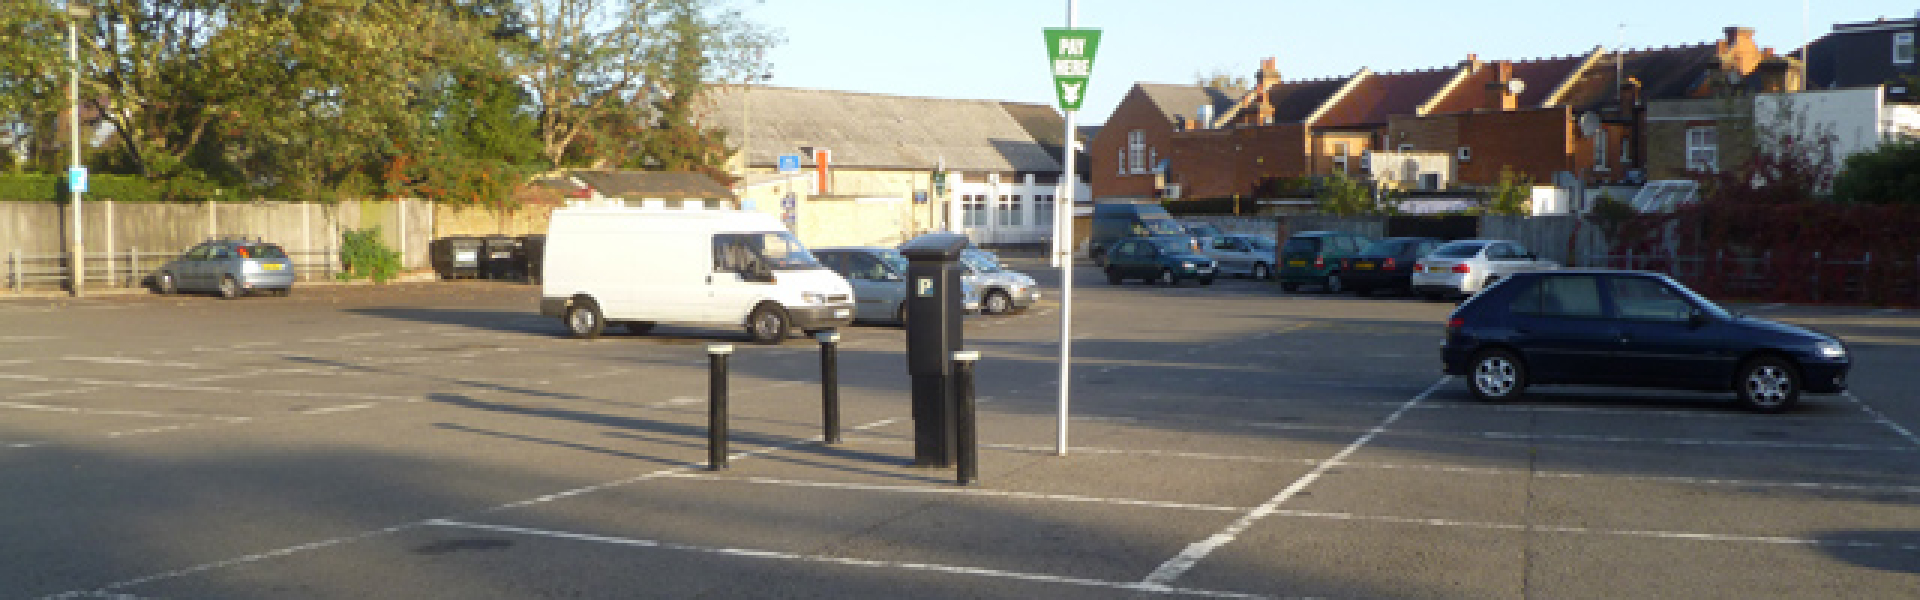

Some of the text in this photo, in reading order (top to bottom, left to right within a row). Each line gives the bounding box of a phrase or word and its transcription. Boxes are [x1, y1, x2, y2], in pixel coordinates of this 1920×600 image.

[1058, 37, 1085, 55] PAY
[1053, 58, 1089, 76] HERE
[919, 278, 933, 296] P
